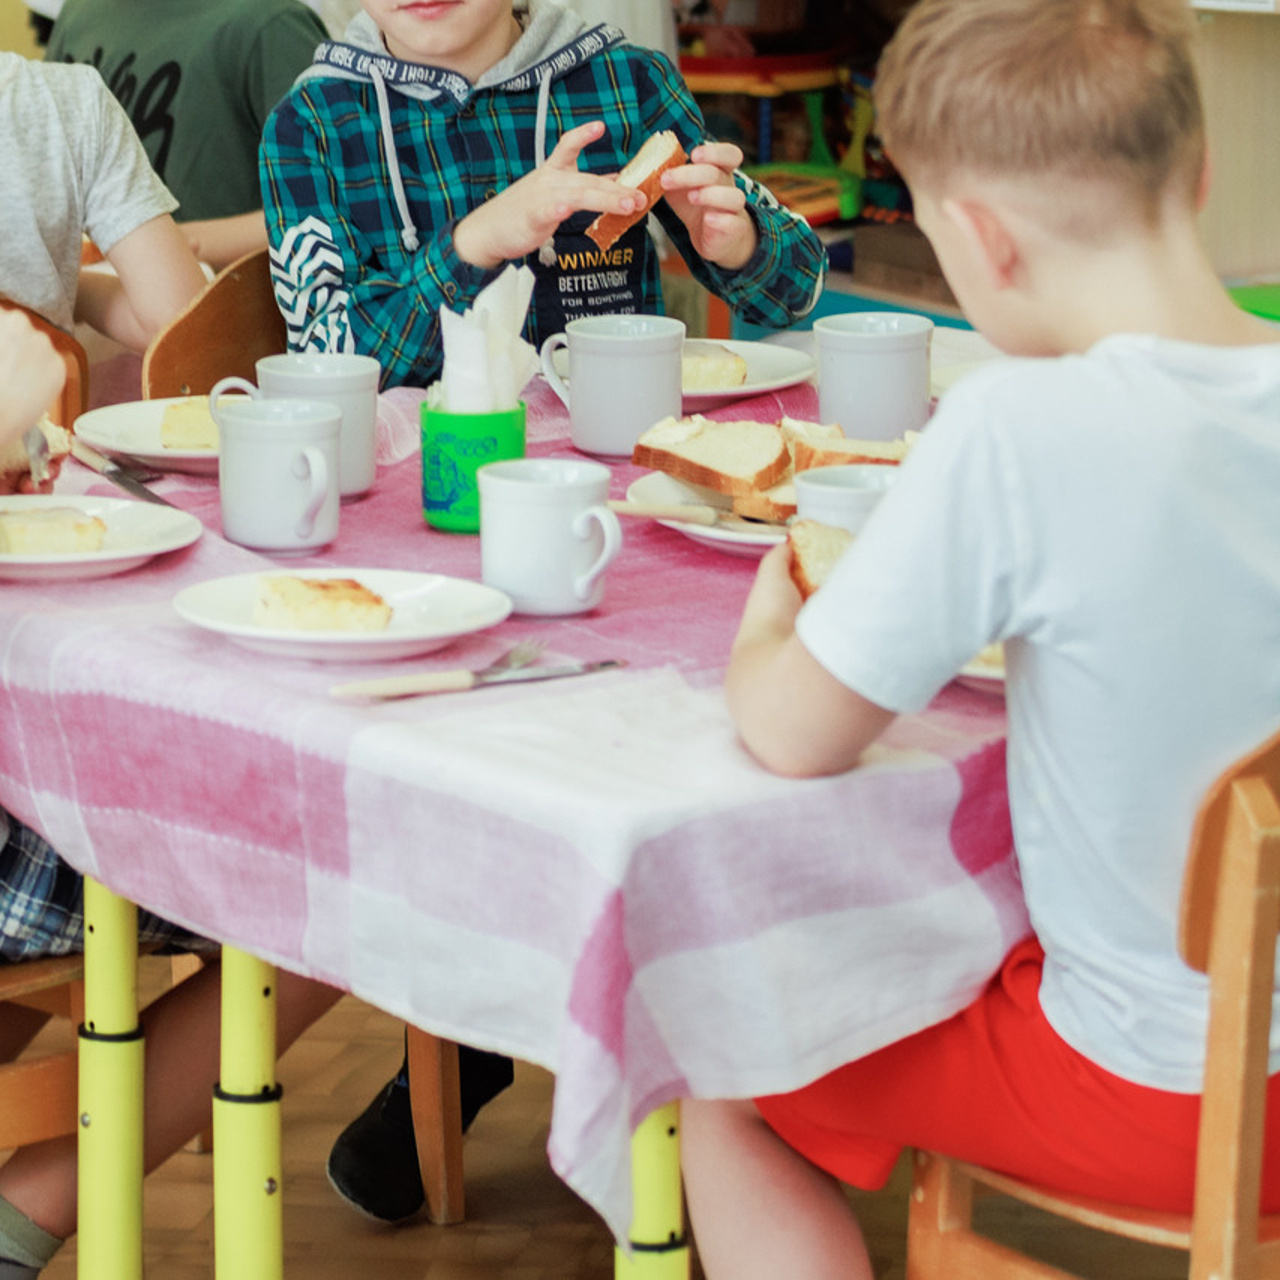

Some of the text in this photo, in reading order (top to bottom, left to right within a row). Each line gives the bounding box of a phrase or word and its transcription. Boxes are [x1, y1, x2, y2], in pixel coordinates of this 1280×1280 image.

[399, 63, 436, 83] FIGHT
[558, 248, 634, 270] WINNER
[561, 297, 583, 307] FOR
